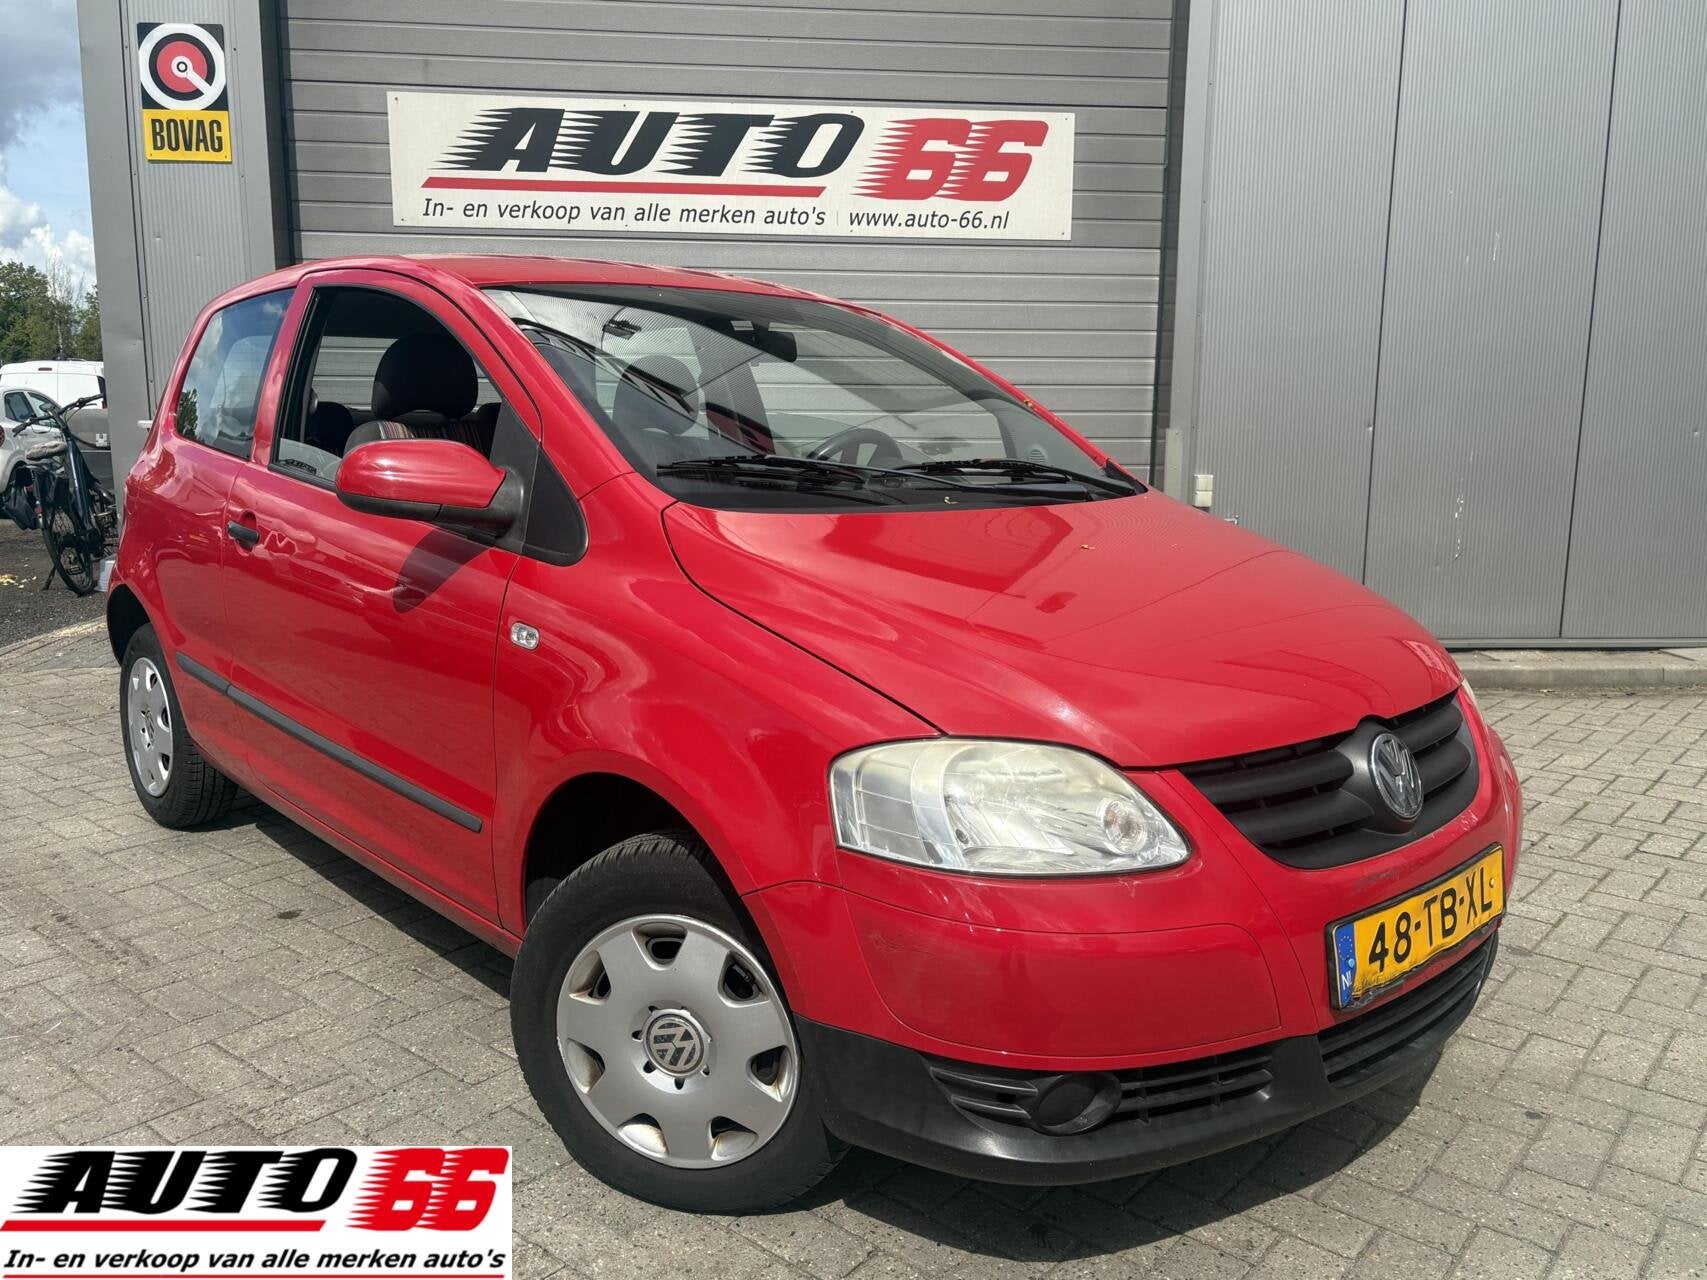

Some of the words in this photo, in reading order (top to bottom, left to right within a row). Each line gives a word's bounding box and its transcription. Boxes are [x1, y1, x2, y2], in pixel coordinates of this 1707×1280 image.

[151, 118, 224, 153] BOVAG
[427, 107, 865, 178] AUTO
[849, 118, 1050, 202] 66
[422, 198, 454, 217] In-
[463, 202, 488, 218] en
[498, 200, 581, 224] verkoop
[590, 206, 626, 221] van
[634, 203, 671, 222] alle
[679, 205, 756, 224] merken
[763, 206, 826, 226] auto's
[849, 210, 1010, 230] www.auto-66.nl
[1368, 866, 1493, 973] 48-TB-XL
